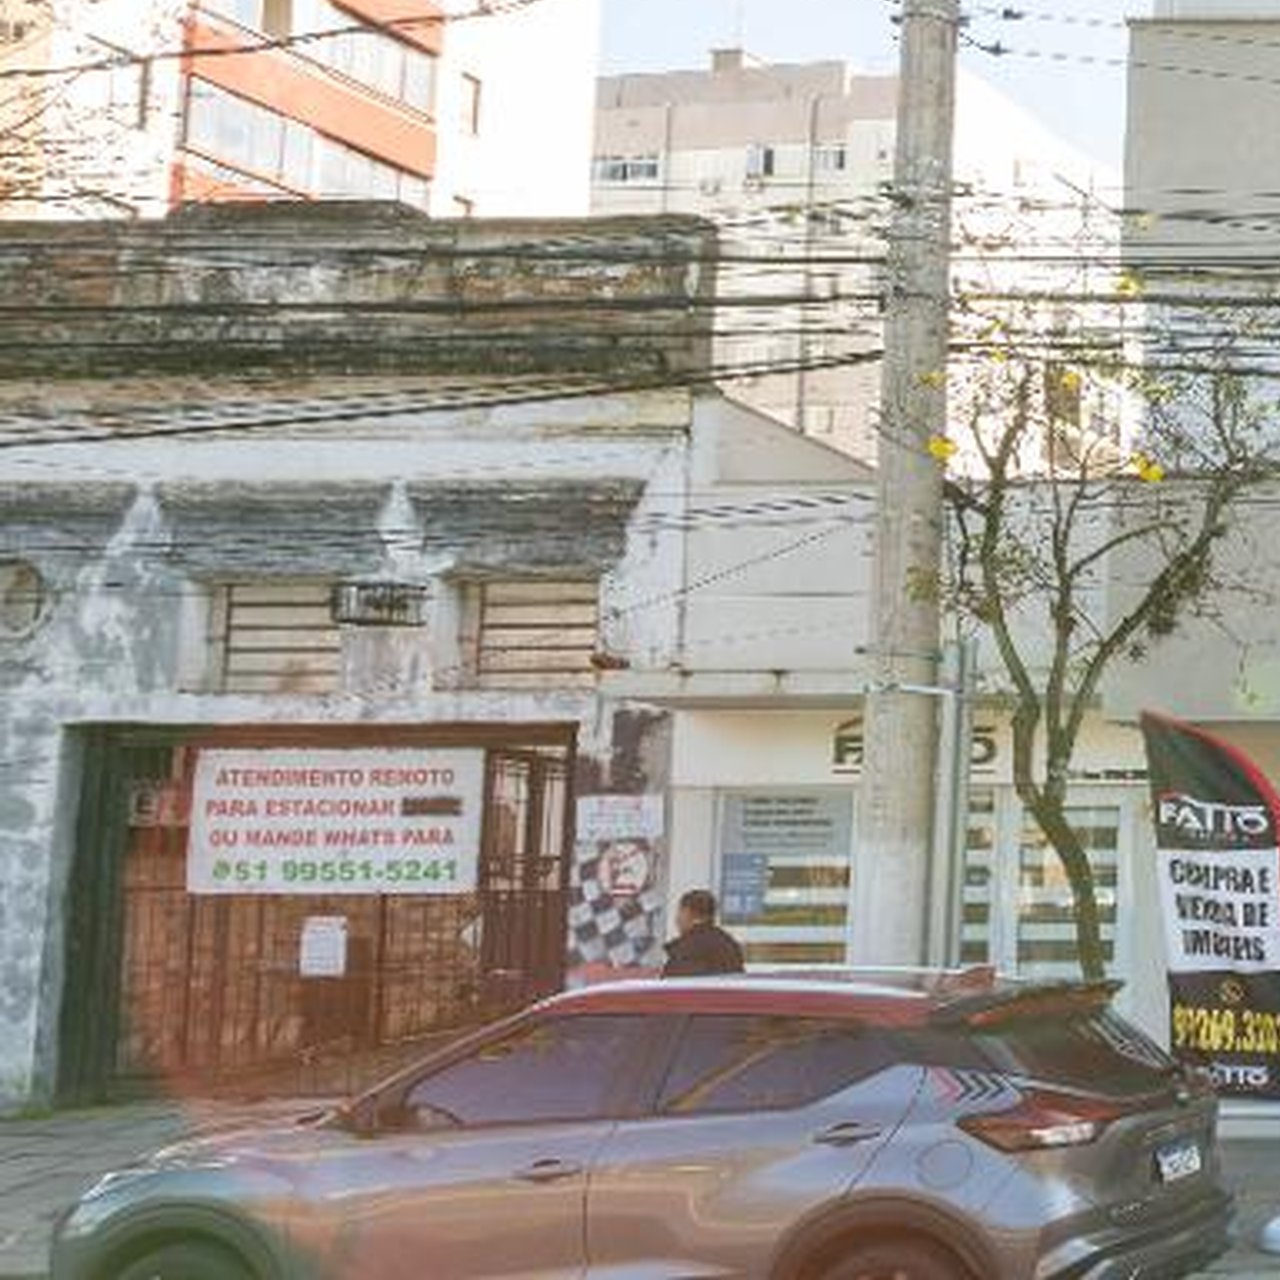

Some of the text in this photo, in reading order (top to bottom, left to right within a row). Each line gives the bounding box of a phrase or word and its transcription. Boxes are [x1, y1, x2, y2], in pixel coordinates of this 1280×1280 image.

[216, 769, 454, 787] ATENDIMENTO REMOTO
[205, 799, 258, 816] PARA
[266, 799, 395, 816] ESTACIONAR
[208, 829, 455, 847] OU MANDE WHATS PARA
[281, 860, 458, 882] 99551-5241
[1168, 859, 1270, 894] COMPRA E
[1242, 902, 1269, 927] DE
